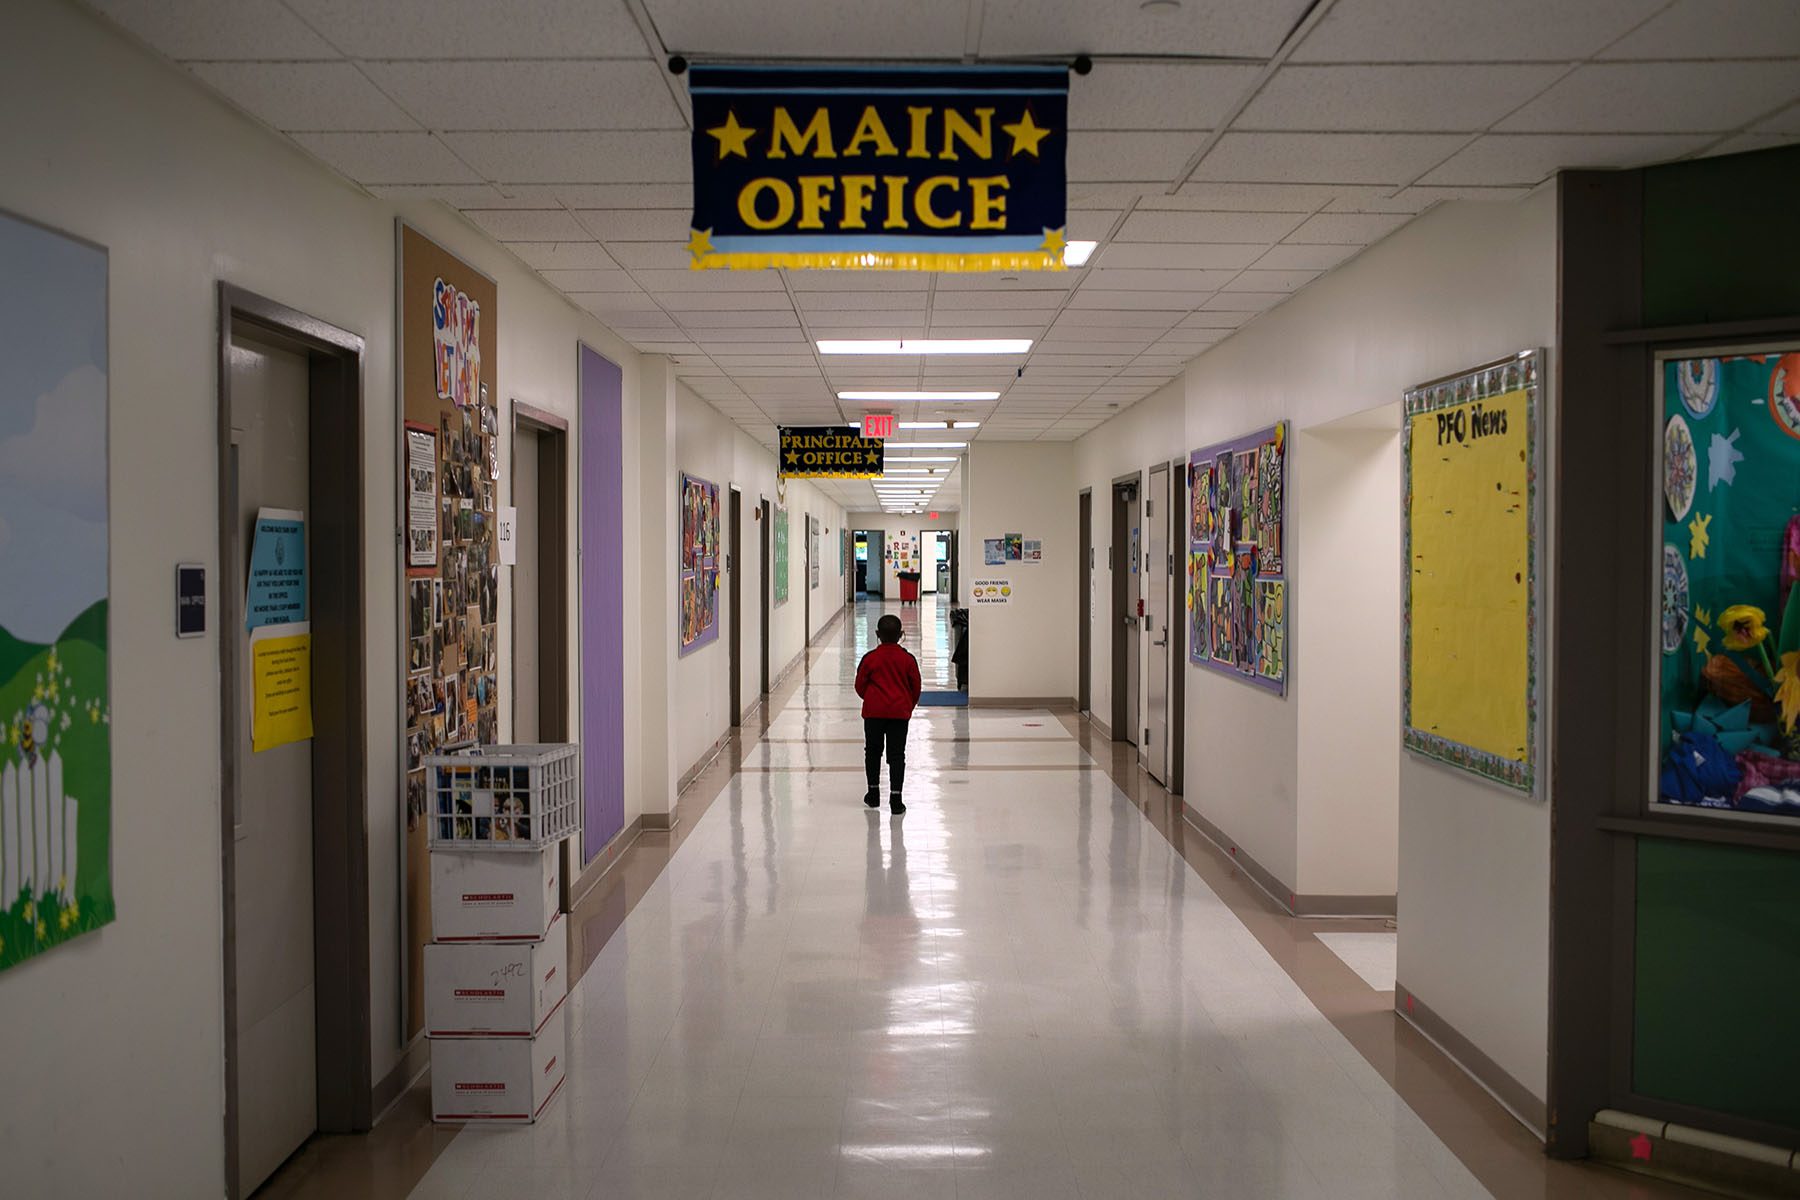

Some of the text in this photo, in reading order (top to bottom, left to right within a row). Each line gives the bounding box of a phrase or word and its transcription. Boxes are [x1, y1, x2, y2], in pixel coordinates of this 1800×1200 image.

[767, 105, 995, 161] MAIN
[737, 174, 1011, 230] OFFICE
[436, 338, 454, 396] PET
[865, 415, 894, 437] EXIT
[1471, 402, 1508, 440] News
[803, 451, 862, 465] OFFICE
[500, 521, 511, 541] 116
